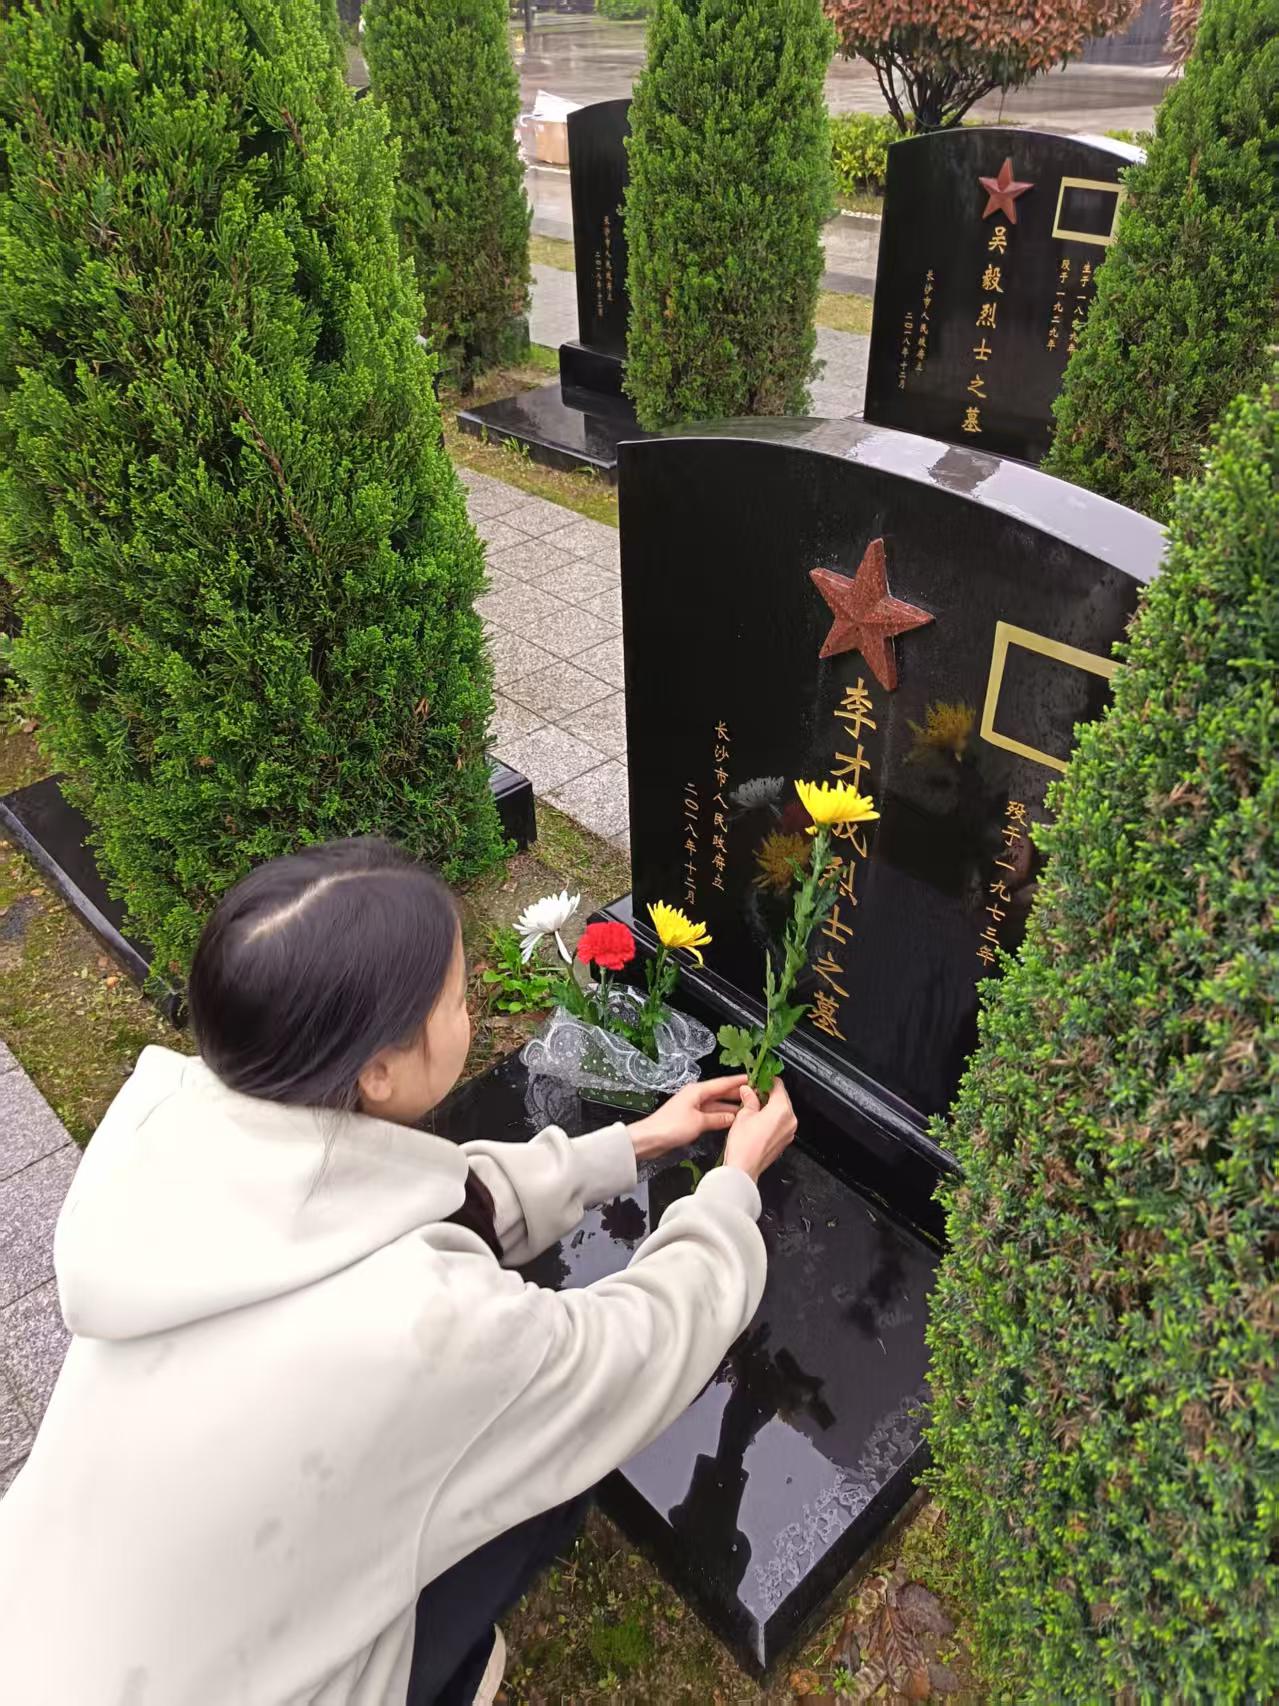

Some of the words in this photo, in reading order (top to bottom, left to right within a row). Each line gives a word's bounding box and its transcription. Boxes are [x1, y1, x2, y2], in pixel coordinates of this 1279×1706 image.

[961, 226, 1008, 433] 吴毅烈士之墓
[1067, 260, 1092, 355] 生于一八九年
[684, 782, 700, 904] 二〇一八年十二月
[711, 720, 731, 891] 长沙市人民政府立
[975, 801, 1028, 966] 殁于一九七三年
